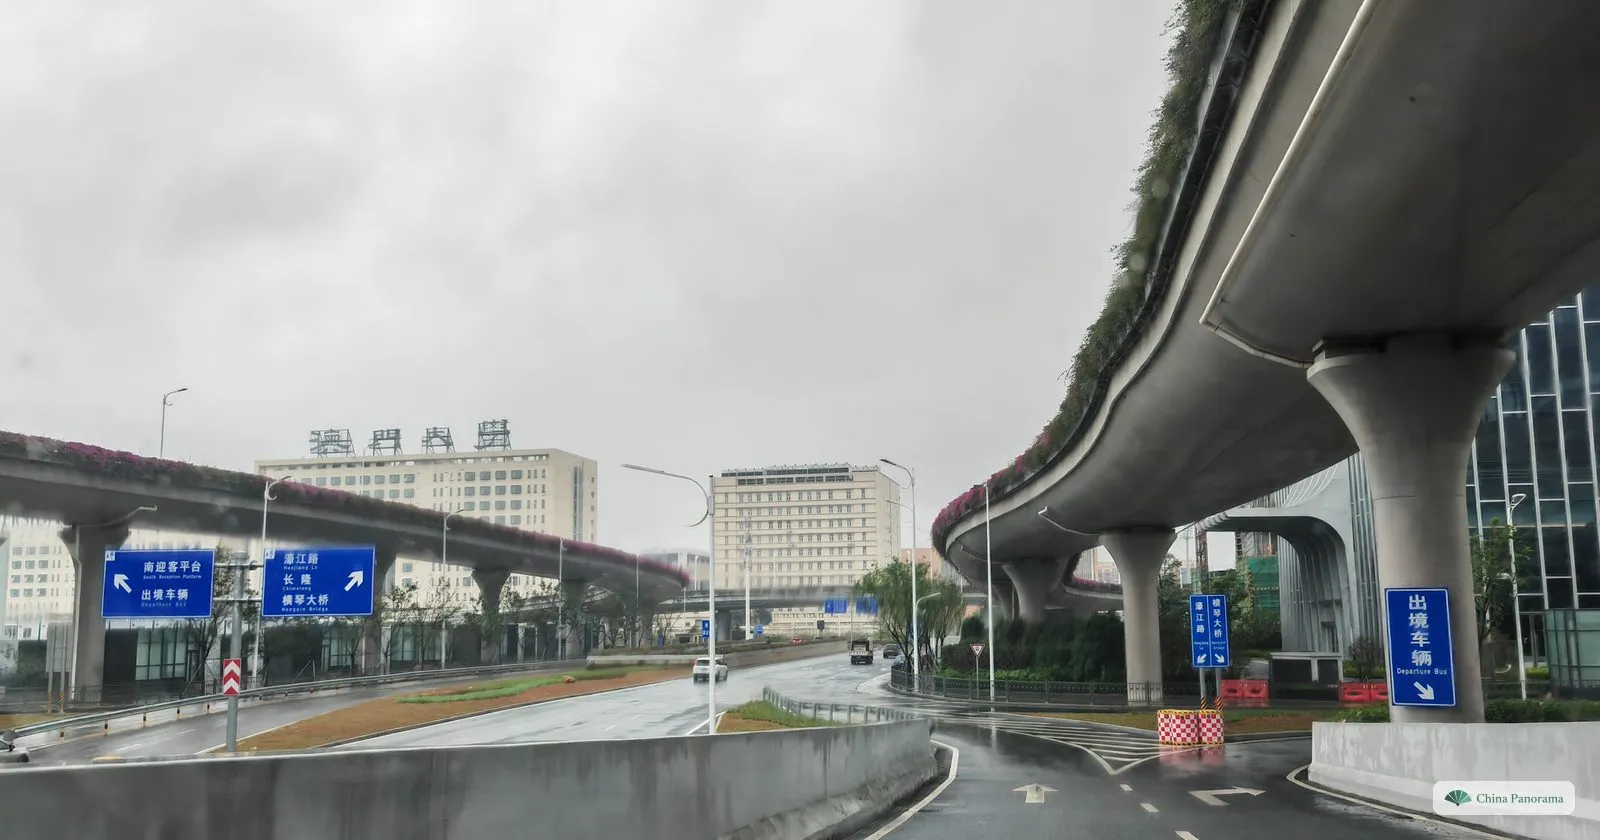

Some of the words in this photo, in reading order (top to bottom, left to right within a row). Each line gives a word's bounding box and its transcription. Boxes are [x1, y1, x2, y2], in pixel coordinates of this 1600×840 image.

[284, 553, 319, 565] 濠江路
[143, 560, 202, 573] 南迎客平台
[141, 588, 189, 601] 出境车辆
[282, 594, 328, 606] 横琴大桥
[1212, 598, 1222, 638] 横琴大桥
[1408, 594, 1432, 667] 出境车辆
[1396, 668, 1431, 676] Departure
